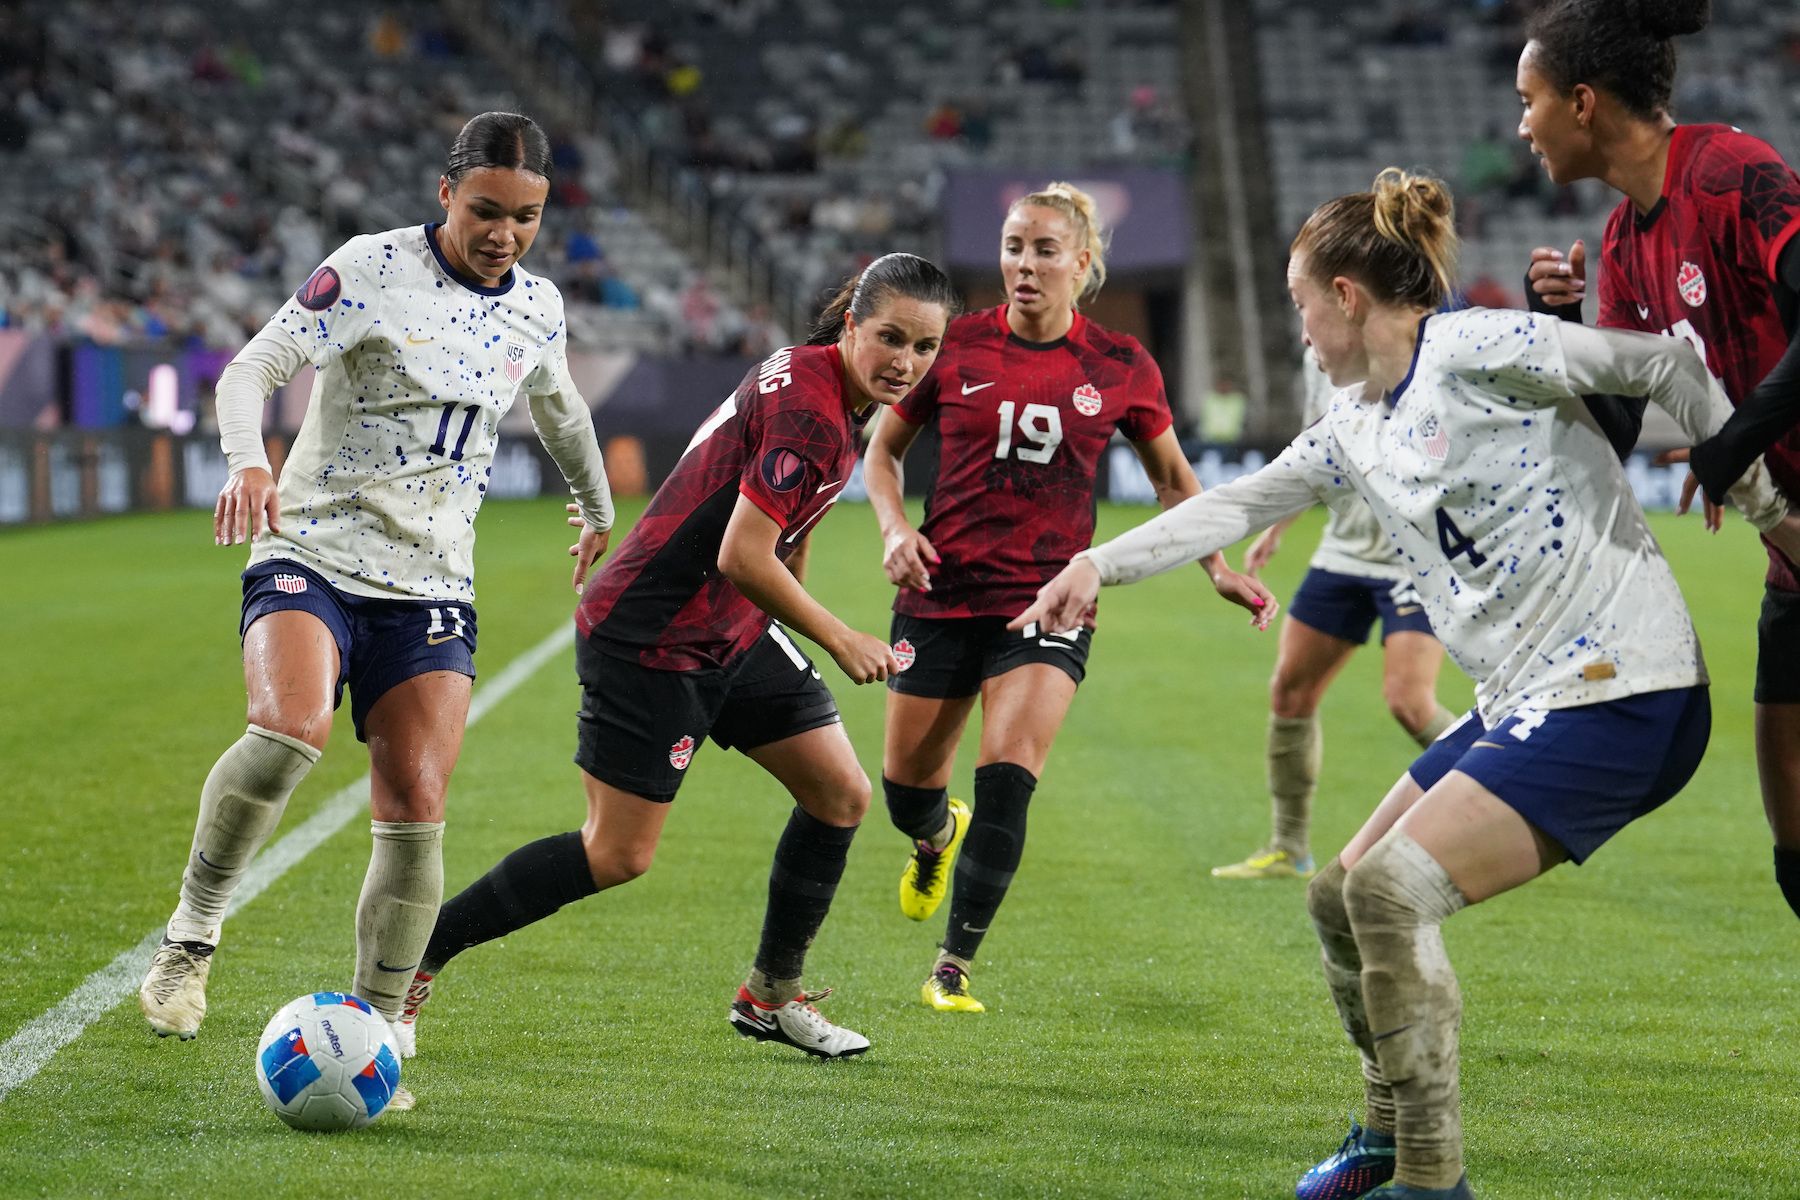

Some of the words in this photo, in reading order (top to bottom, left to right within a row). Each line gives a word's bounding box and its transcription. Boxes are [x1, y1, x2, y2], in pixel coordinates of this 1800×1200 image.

[507, 344, 524, 362] USA
[428, 401, 481, 461] 11
[995, 400, 1063, 464] 19
[1436, 506, 1487, 568] 4
[321, 1020, 344, 1058] molten
